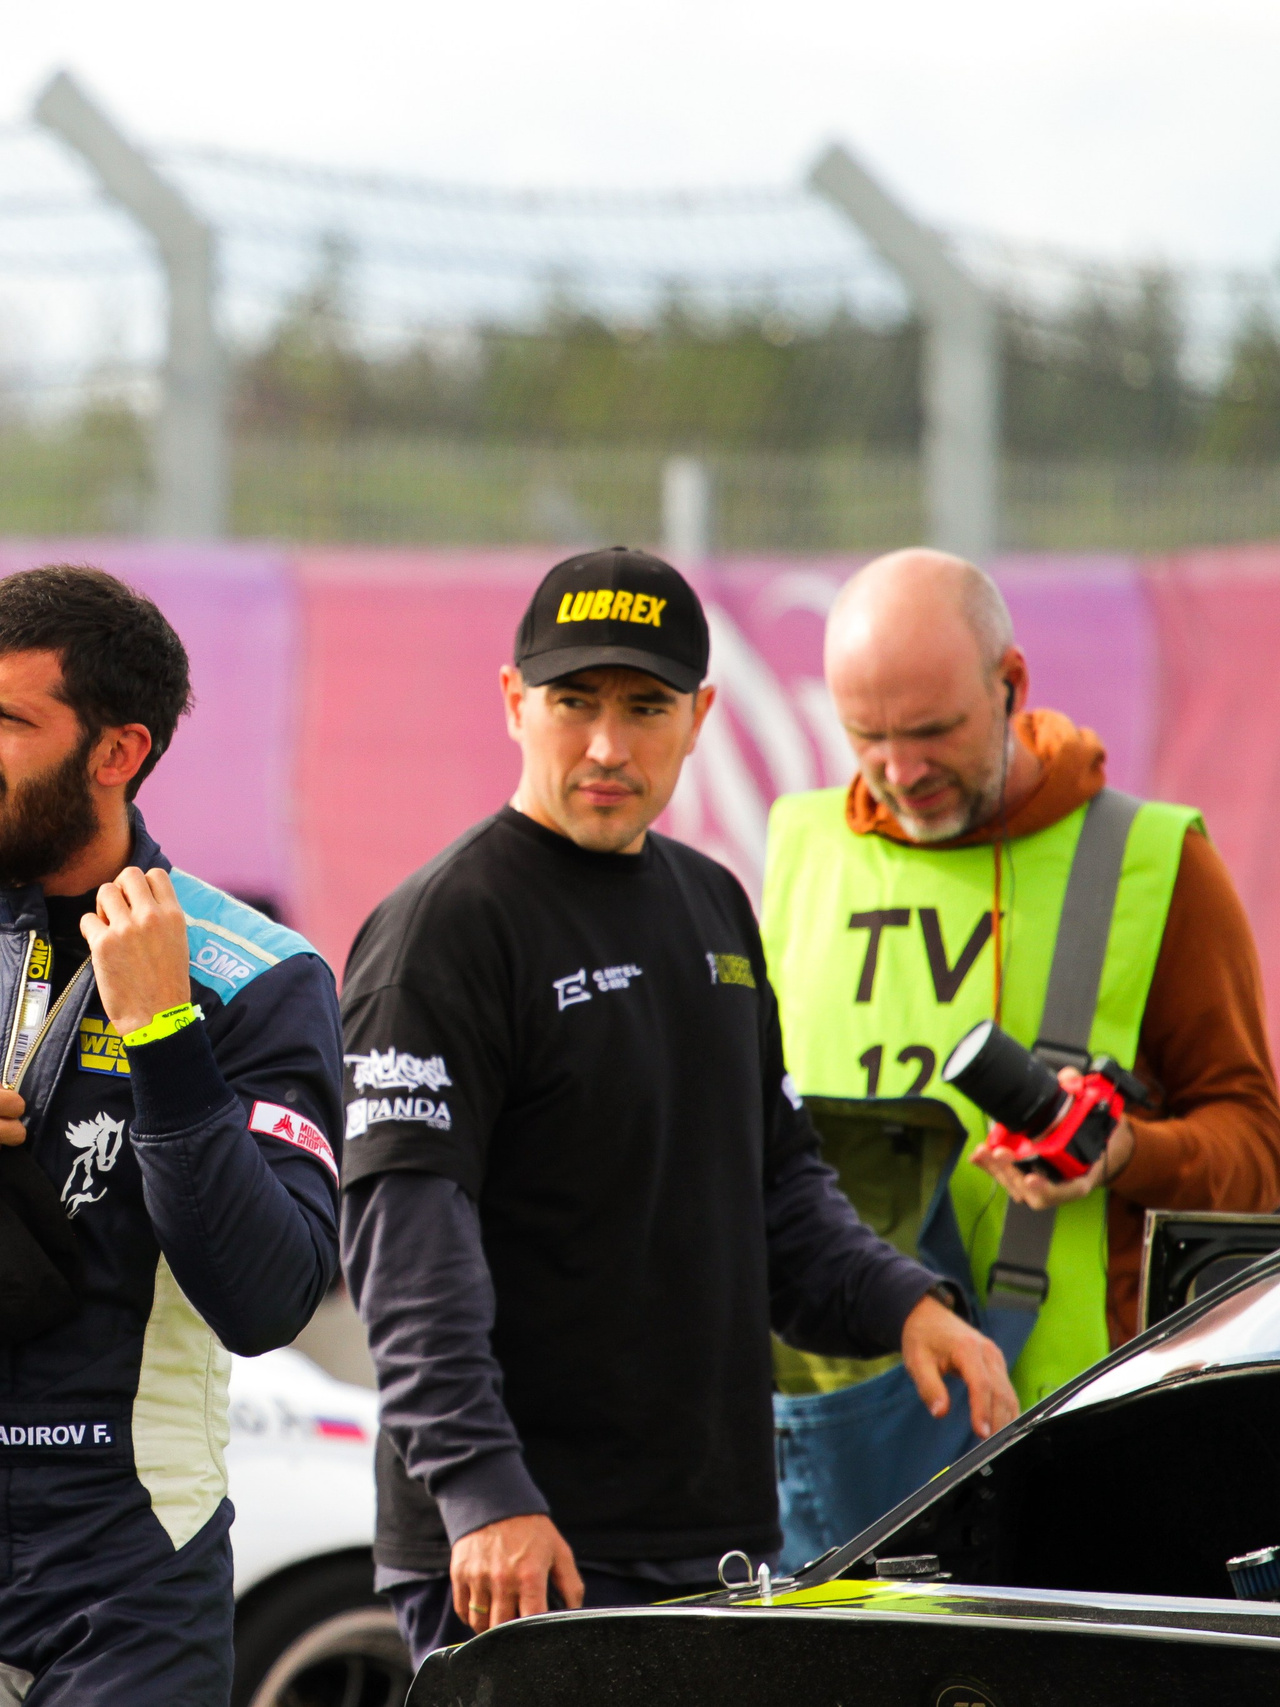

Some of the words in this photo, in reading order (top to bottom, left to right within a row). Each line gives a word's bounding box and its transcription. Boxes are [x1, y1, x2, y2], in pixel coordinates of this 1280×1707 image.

[556, 589, 667, 628] LUBREX
[27, 938, 49, 979] OMP
[196, 945, 250, 979] OMP
[848, 907, 1004, 1004] TV
[368, 1096, 452, 1121] PANDA
[93, 1424, 112, 1444] F.
